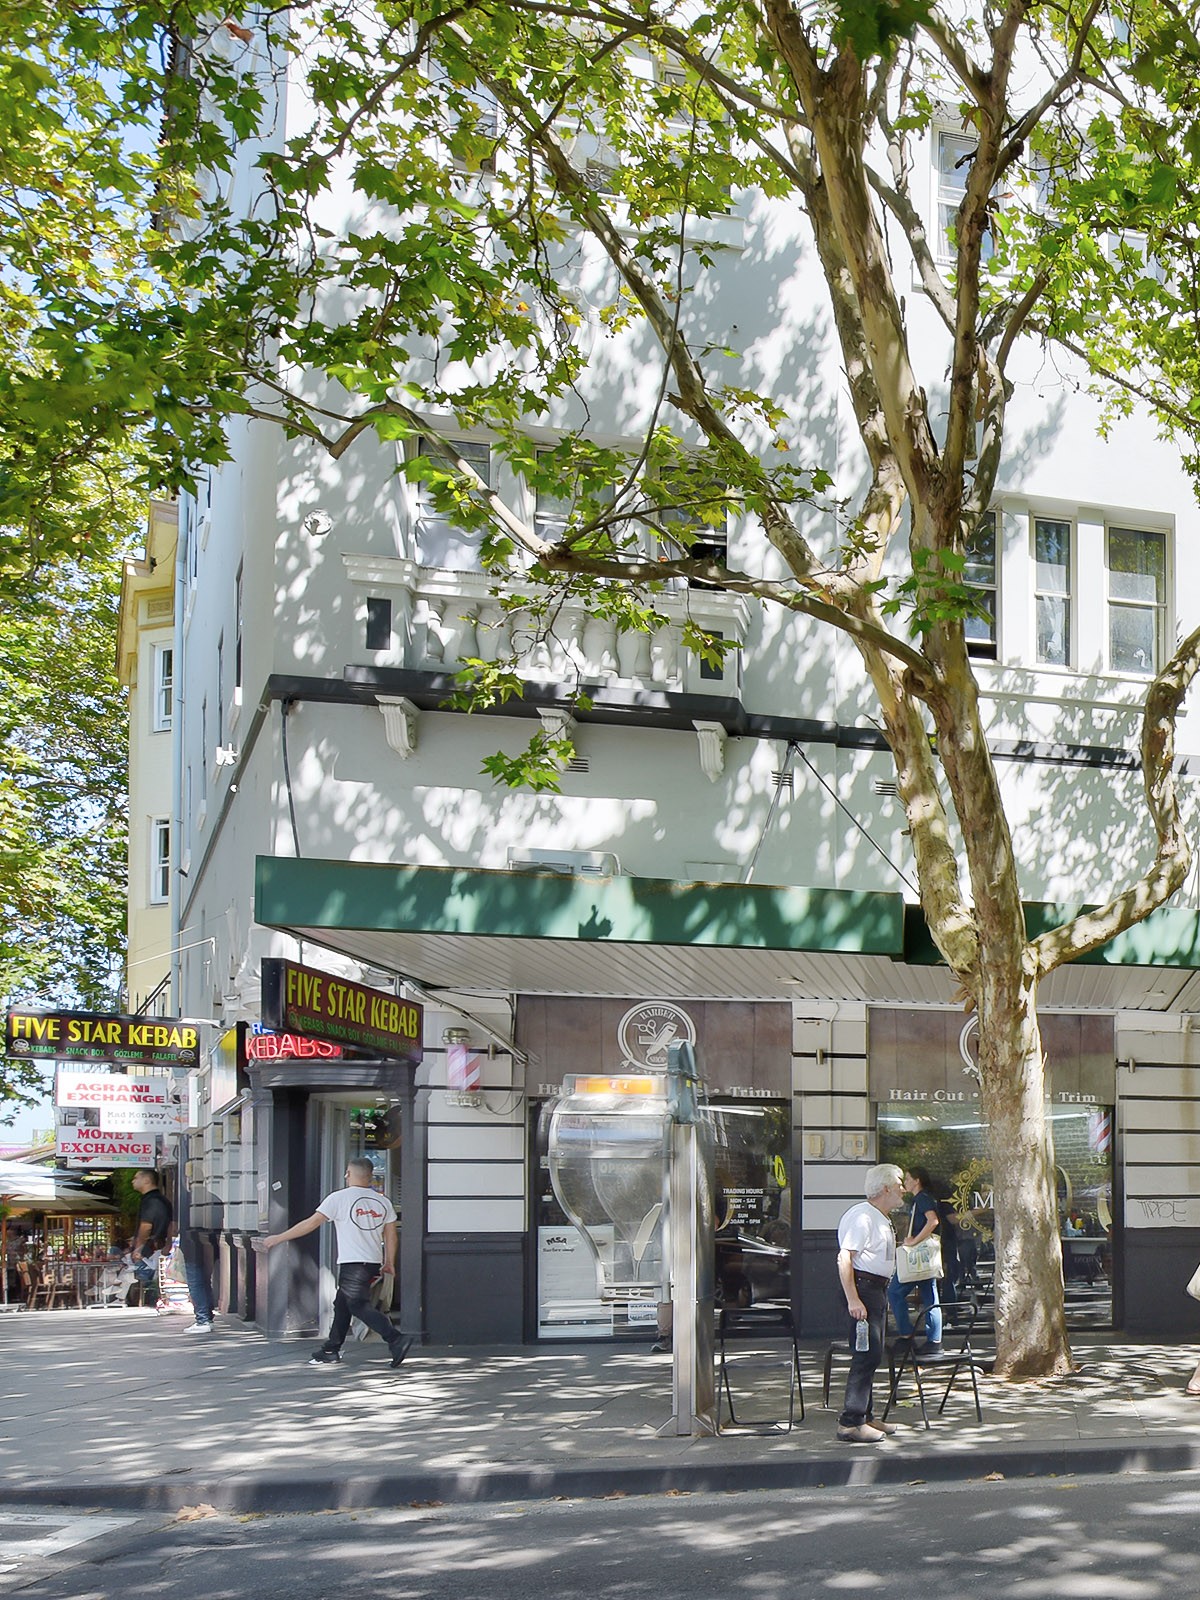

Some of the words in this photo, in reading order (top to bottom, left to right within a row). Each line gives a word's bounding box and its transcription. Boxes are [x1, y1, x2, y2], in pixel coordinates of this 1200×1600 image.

[288, 969, 323, 1012] FIVE
[328, 982, 366, 1025] STAR
[371, 996, 418, 1039] KEBAB
[639, 1008, 676, 1020] BARBER
[12, 1016, 61, 1041] FIVE
[68, 1020, 122, 1045] STAR
[128, 1025, 197, 1049] KEBAB
[31, 1045, 57, 1054] KEBABS
[65, 1047, 89, 1056] SNACK
[91, 1048, 105, 1056] BOX
[114, 1049, 144, 1059] GÖZLEME
[75, 1083, 150, 1093] AGRANI
[67, 1093, 165, 1103] EXCHANGE
[889, 1089, 928, 1100] Hair
[932, 1090, 964, 1101] Cut
[1058, 1091, 1097, 1103] Trim
[129, 1111, 166, 1120] Monkey
[61, 1143, 152, 1154] EXCHANGE
[546, 1237, 568, 1246] MSA
